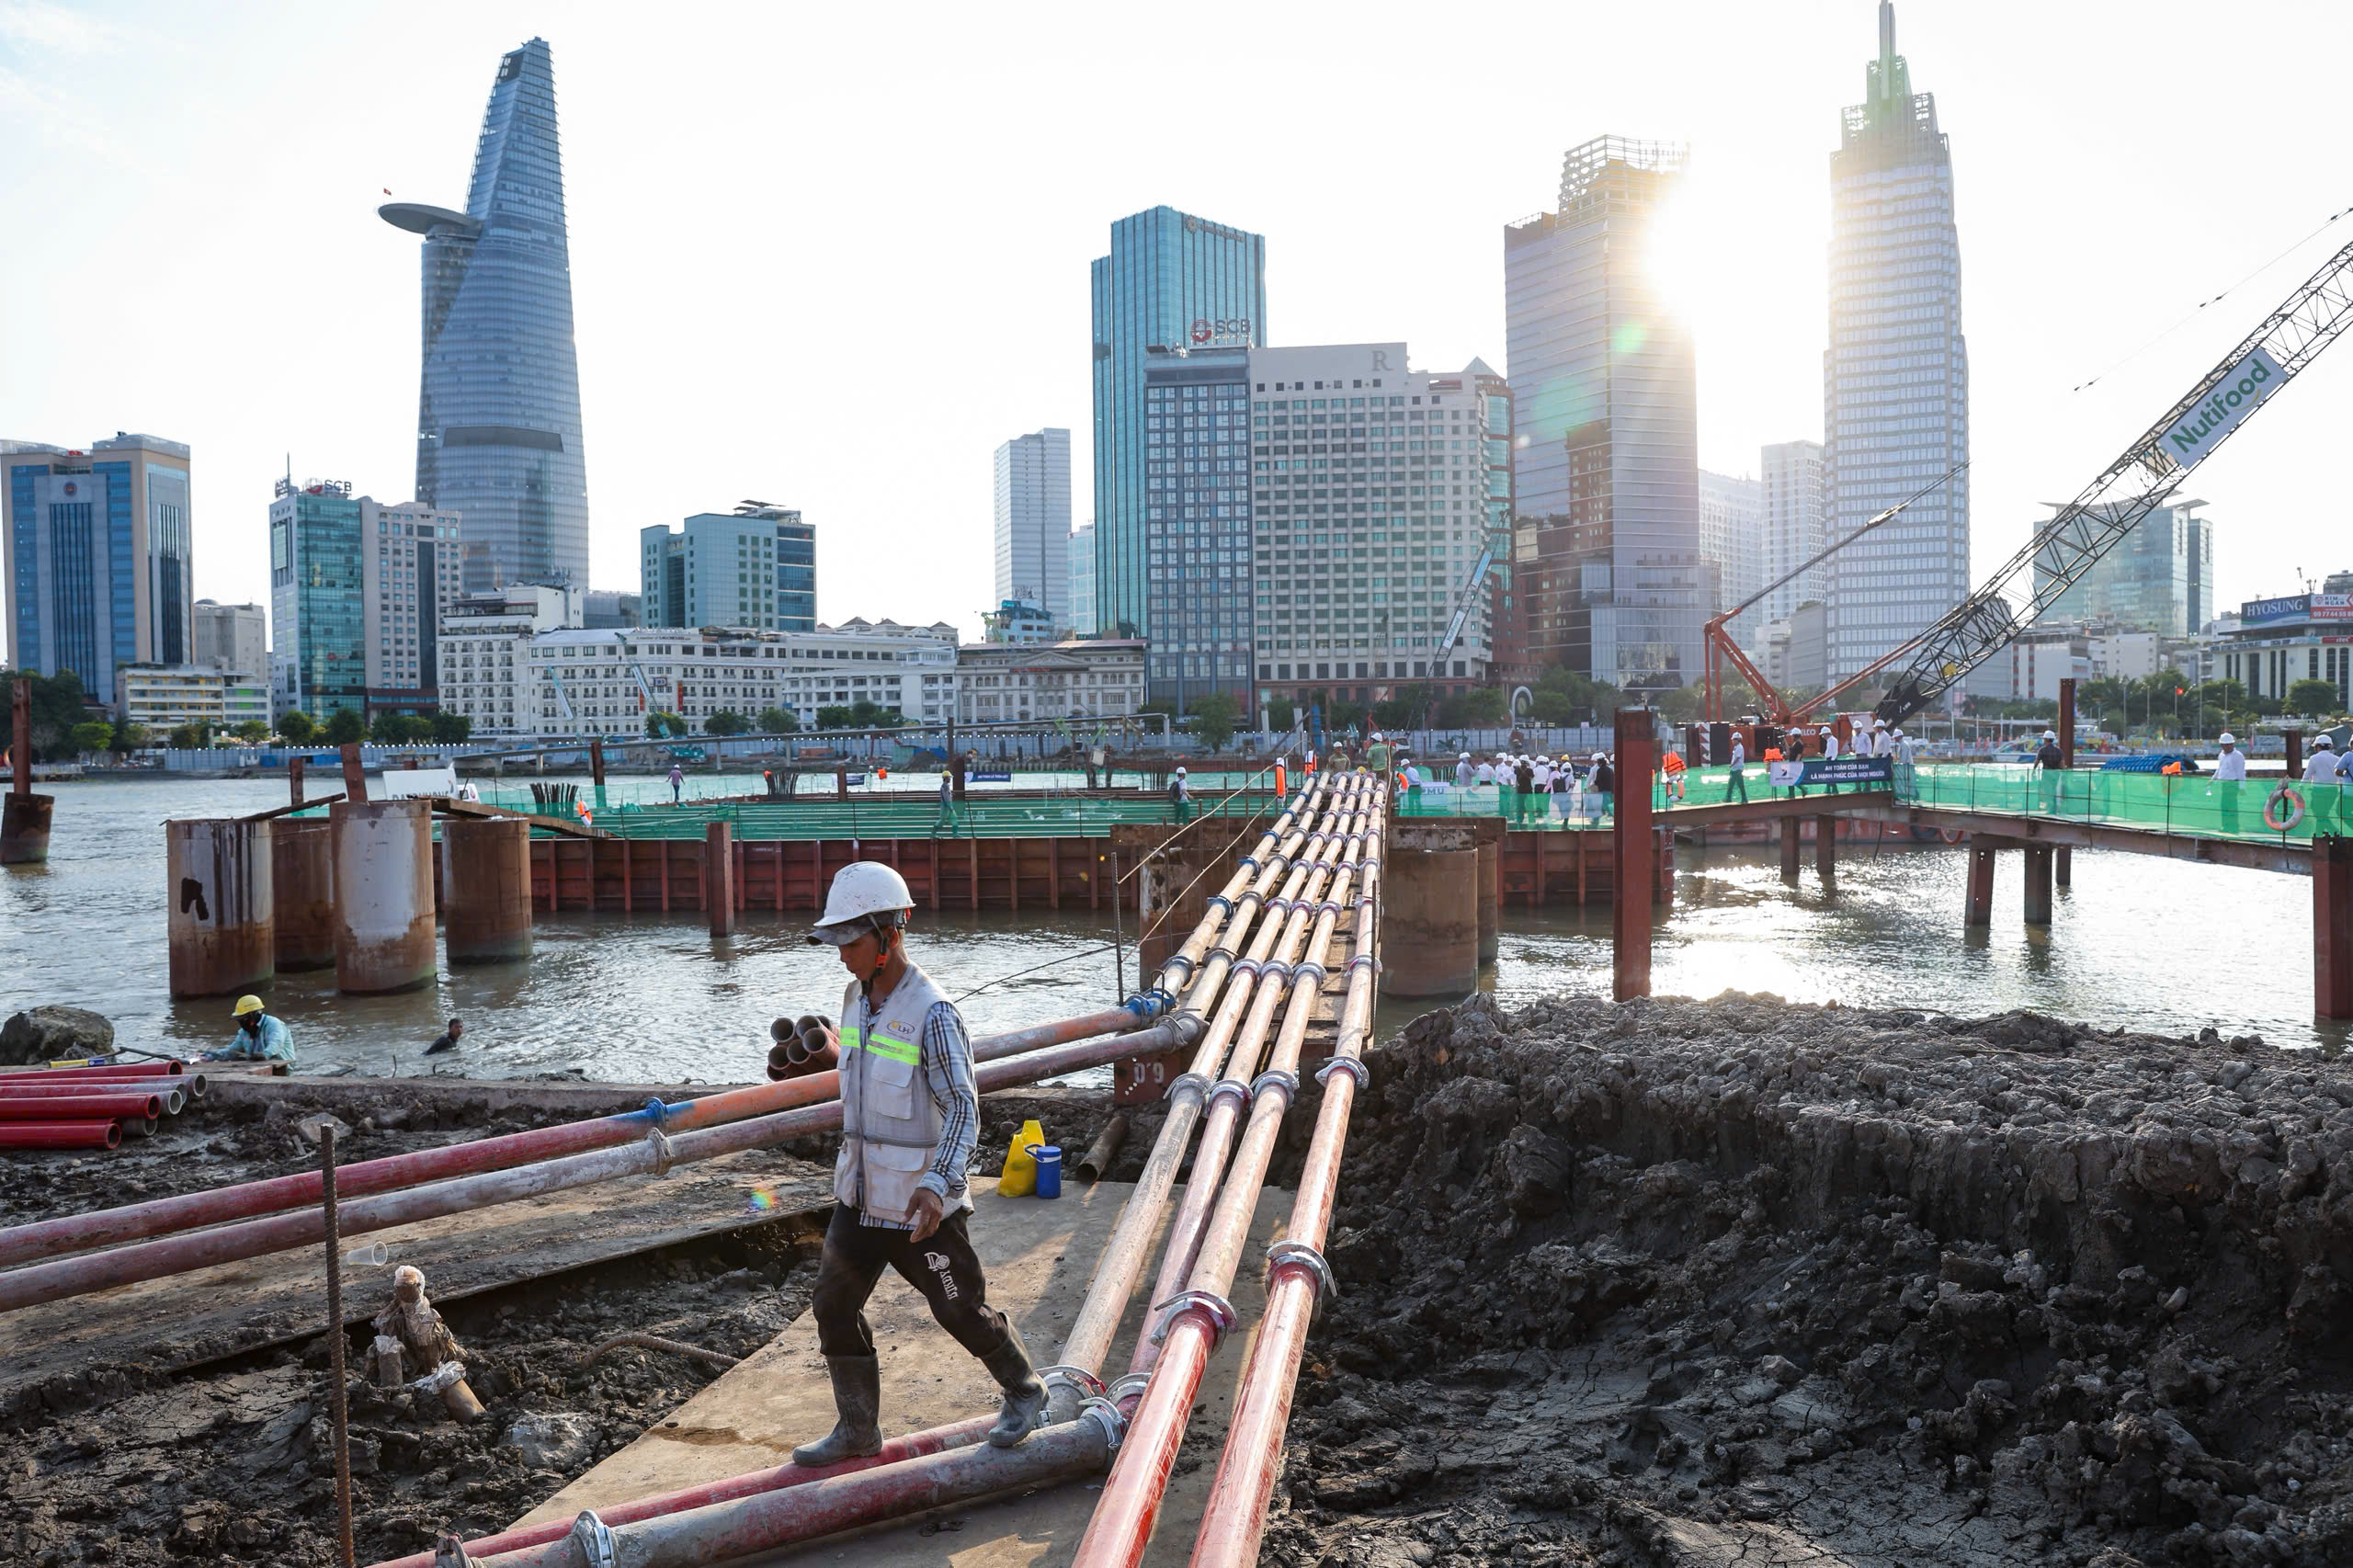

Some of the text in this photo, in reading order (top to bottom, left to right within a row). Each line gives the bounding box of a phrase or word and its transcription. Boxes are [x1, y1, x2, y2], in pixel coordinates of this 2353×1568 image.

[1215, 318, 1250, 334] SCB
[1370, 350, 1394, 371] R
[2170, 358, 2272, 454] Nutifood
[324, 479, 352, 492] SCB
[2246, 598, 2303, 618] HYOSUNG
